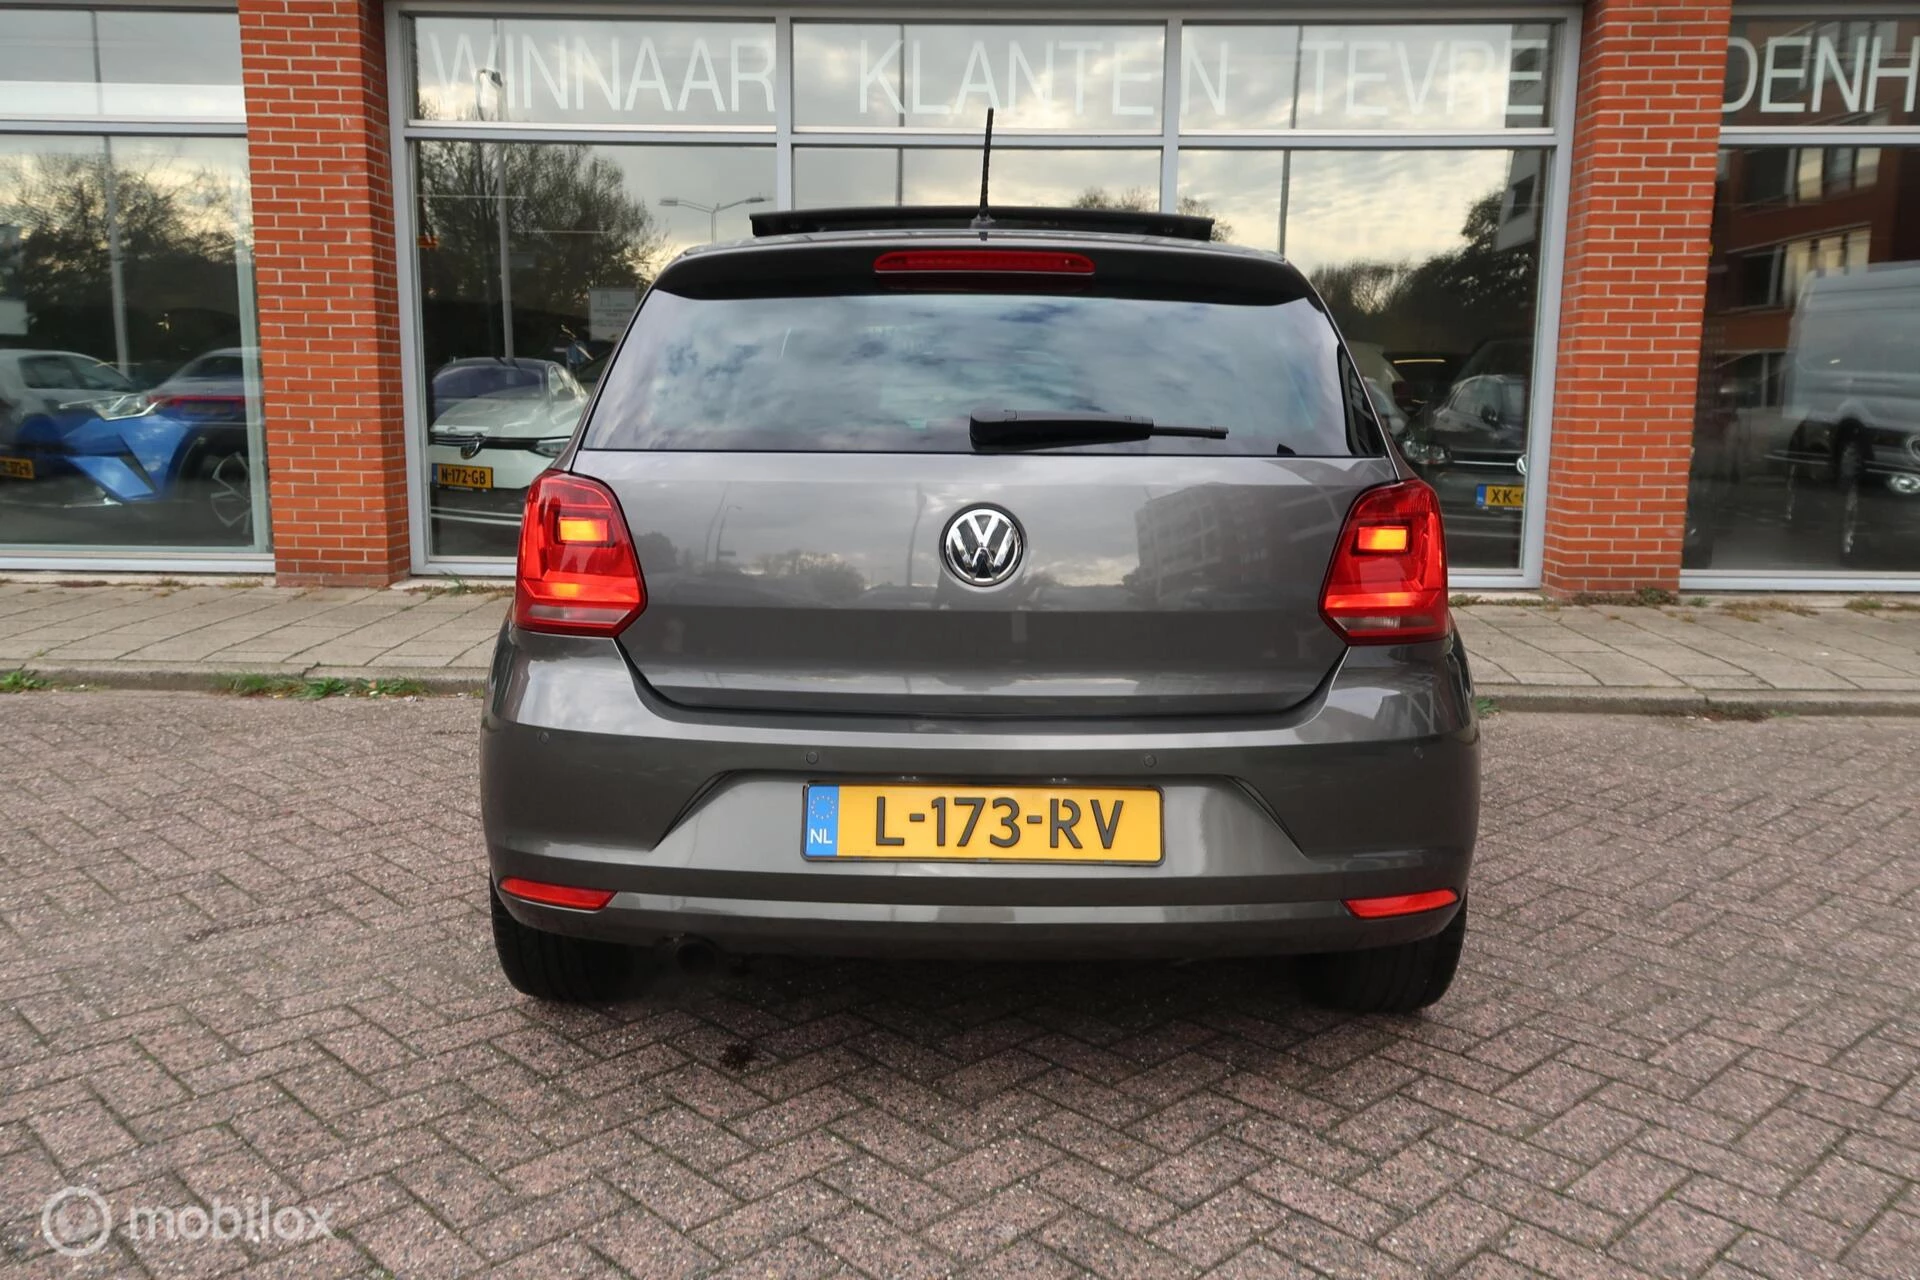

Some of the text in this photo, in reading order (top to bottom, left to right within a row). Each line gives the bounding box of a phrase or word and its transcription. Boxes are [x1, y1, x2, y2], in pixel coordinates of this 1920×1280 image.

[430, 33, 776, 113] WINNAAR
[1299, 39, 1547, 116] TEVRE
[1491, 489, 1524, 505] XK-
[810, 829, 832, 844] NL
[876, 796, 1124, 849] L-173-RV
